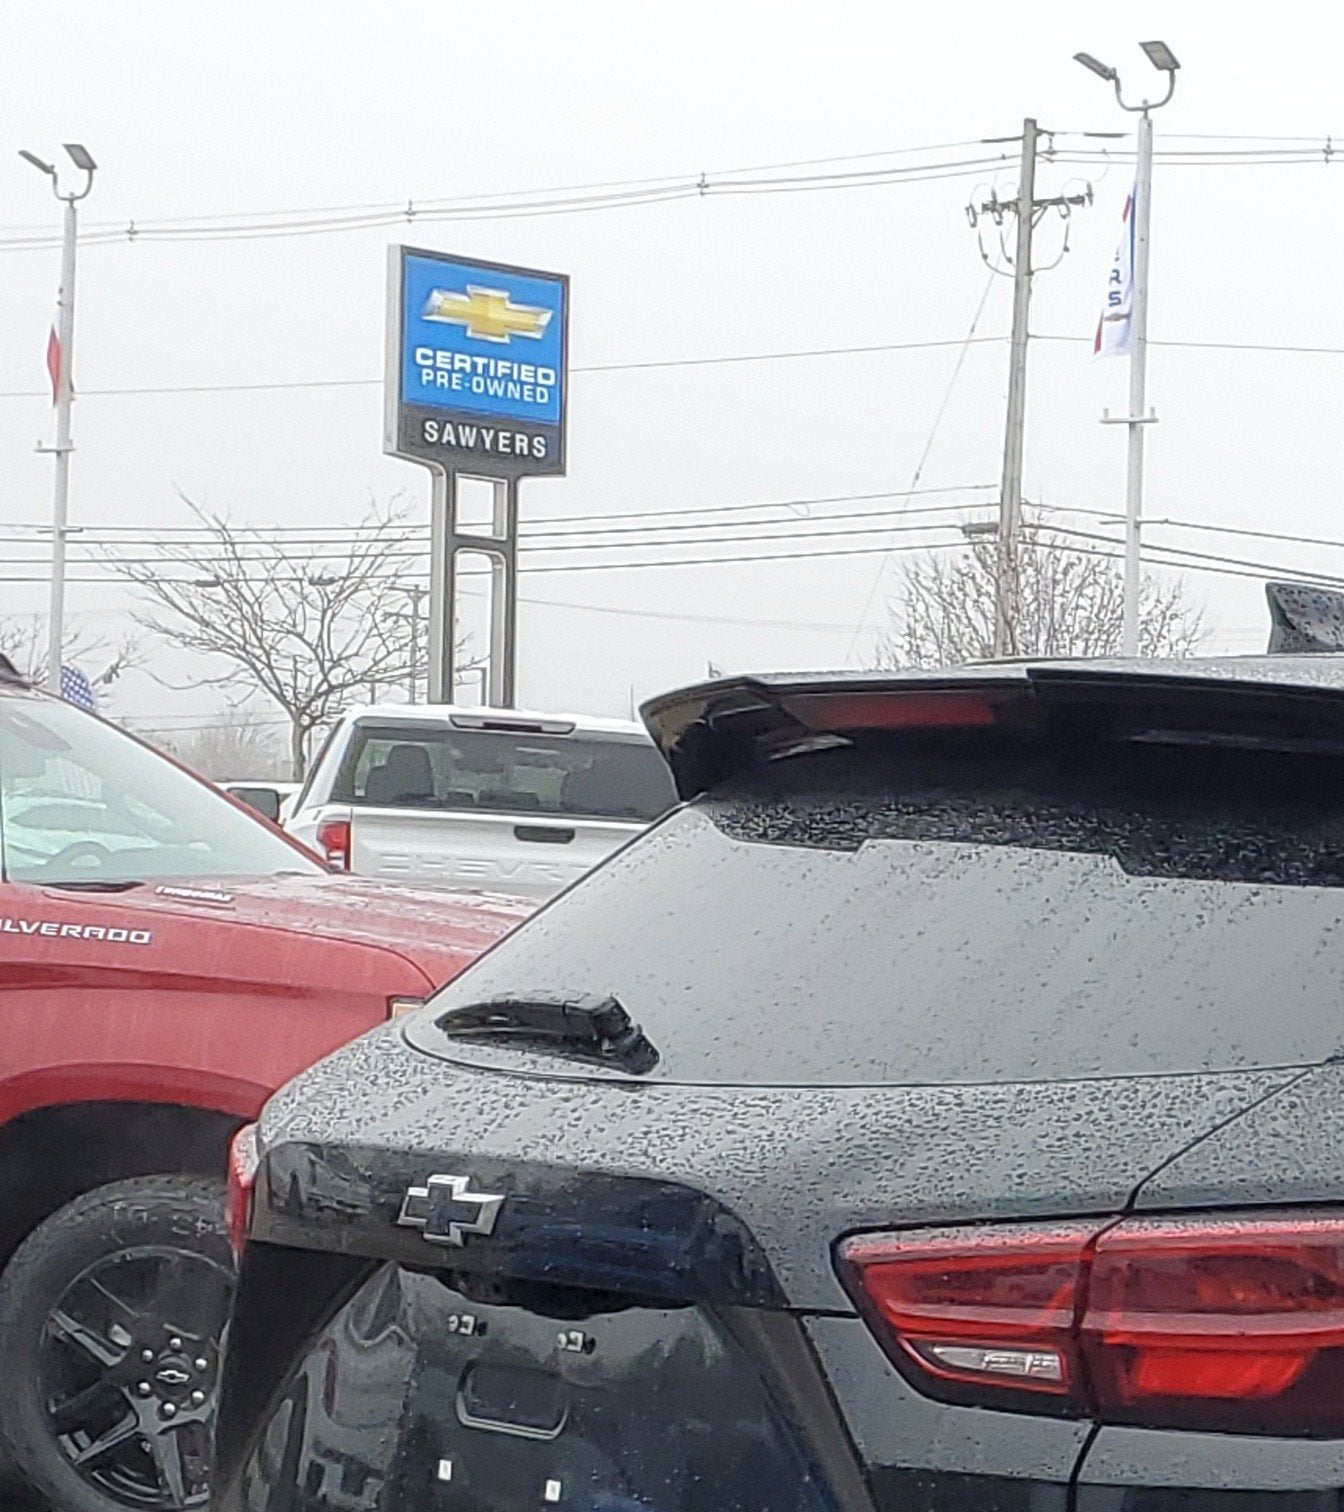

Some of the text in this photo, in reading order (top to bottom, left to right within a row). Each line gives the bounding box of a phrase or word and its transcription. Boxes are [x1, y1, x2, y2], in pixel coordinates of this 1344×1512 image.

[415, 347, 555, 385] CERTIFIED
[421, 368, 549, 403] PRE-OWNED
[423, 420, 547, 458] SAWYERS
